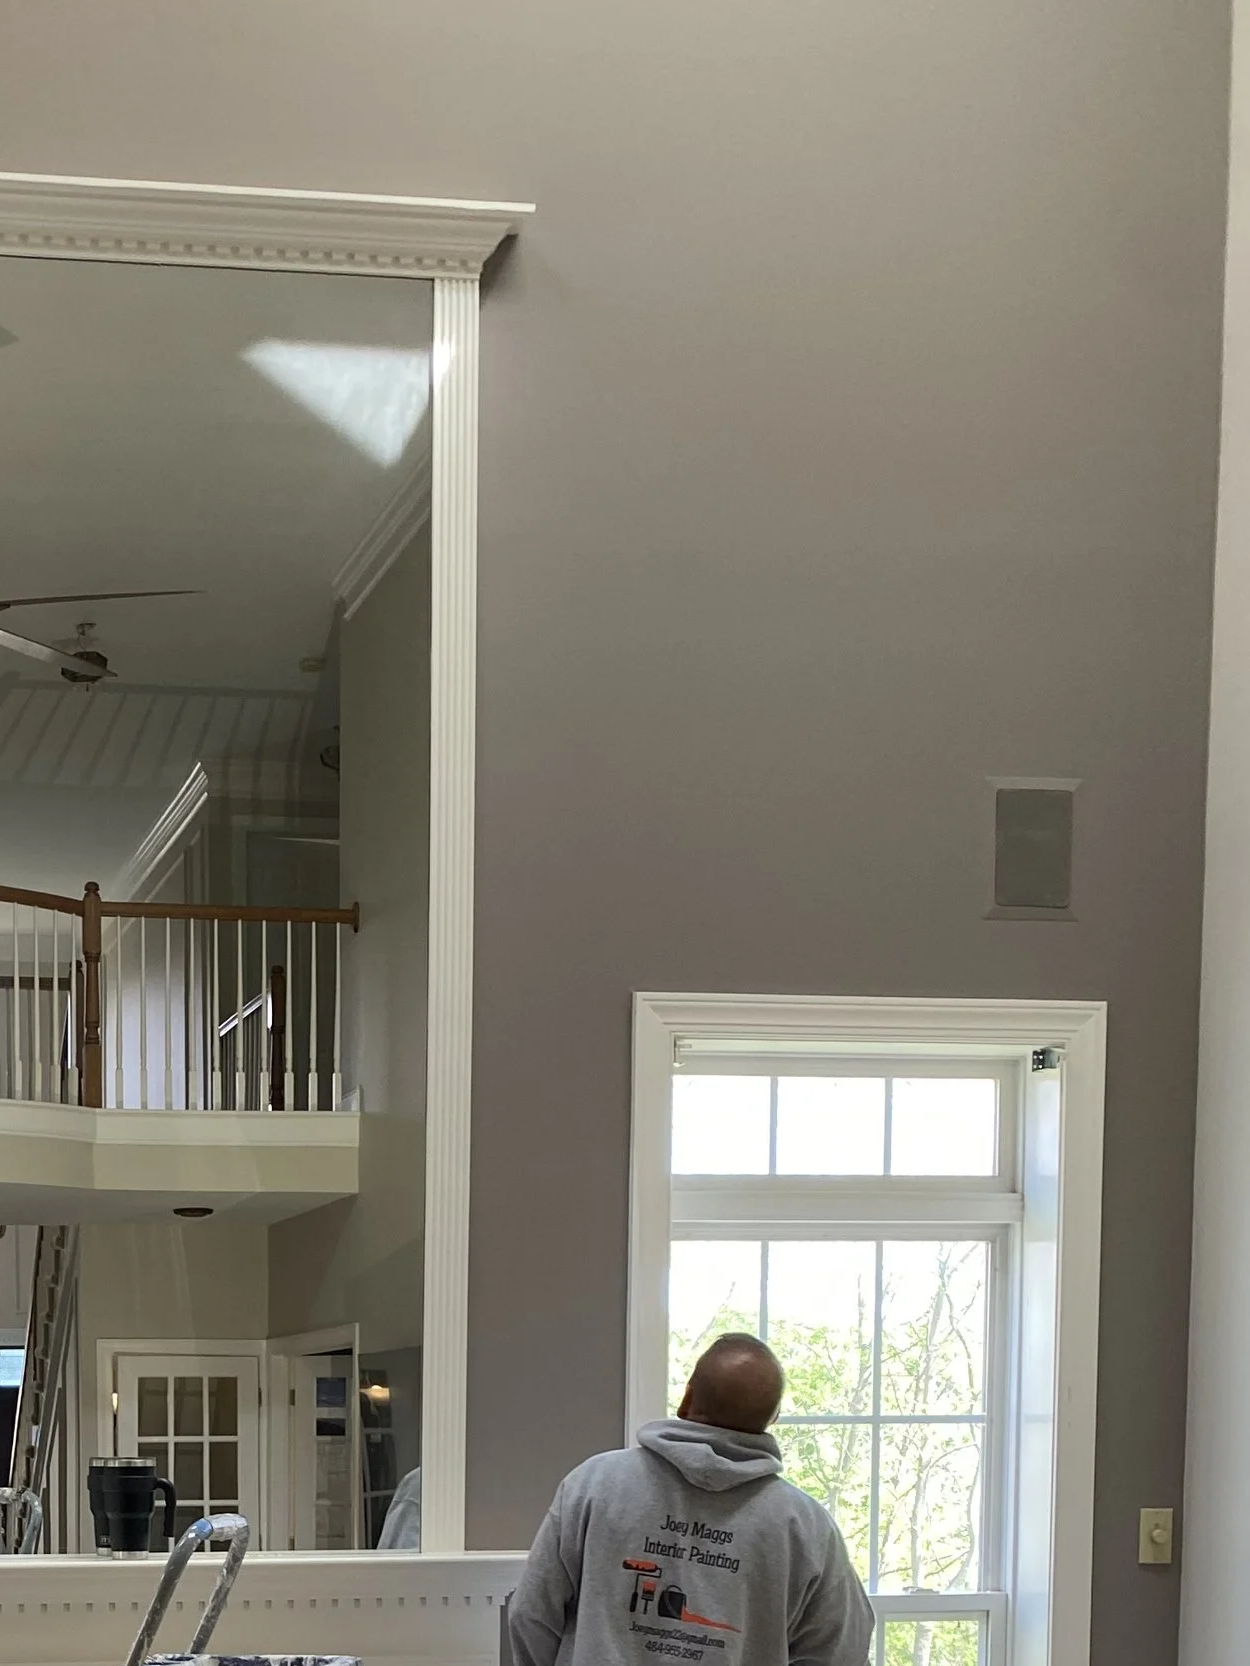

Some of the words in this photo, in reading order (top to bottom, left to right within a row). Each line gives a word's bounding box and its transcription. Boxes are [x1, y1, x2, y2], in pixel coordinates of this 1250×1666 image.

[660, 1514, 689, 1537] Joey
[691, 1521, 734, 1545] Maggs
[643, 1537, 687, 1560] Interior
[688, 1546, 740, 1574] Painting
